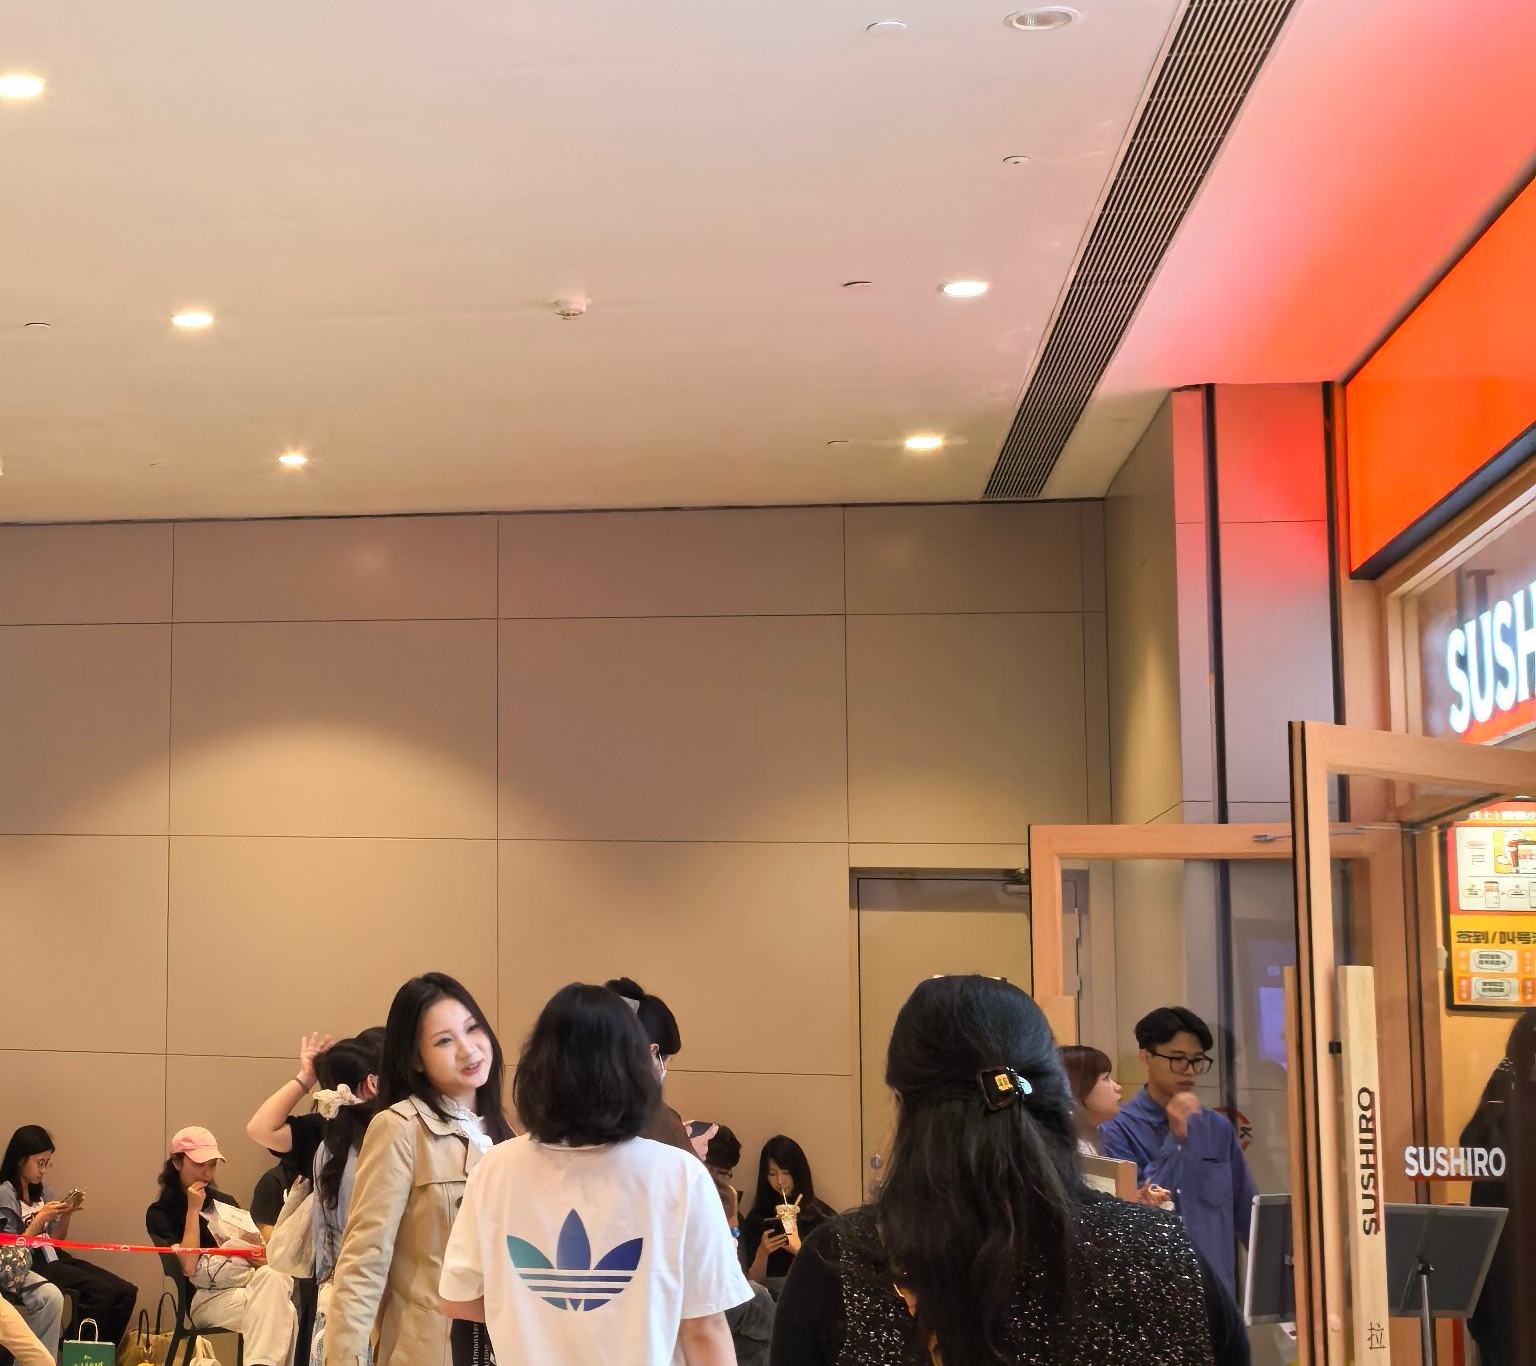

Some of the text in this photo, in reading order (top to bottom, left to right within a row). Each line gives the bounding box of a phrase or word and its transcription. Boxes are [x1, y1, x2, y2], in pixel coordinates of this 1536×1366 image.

[1358, 1087, 1379, 1236] SUSHIRO
[1404, 1146, 1506, 1178] SUSHIRO
[1367, 1321, 1386, 1350] 拉
